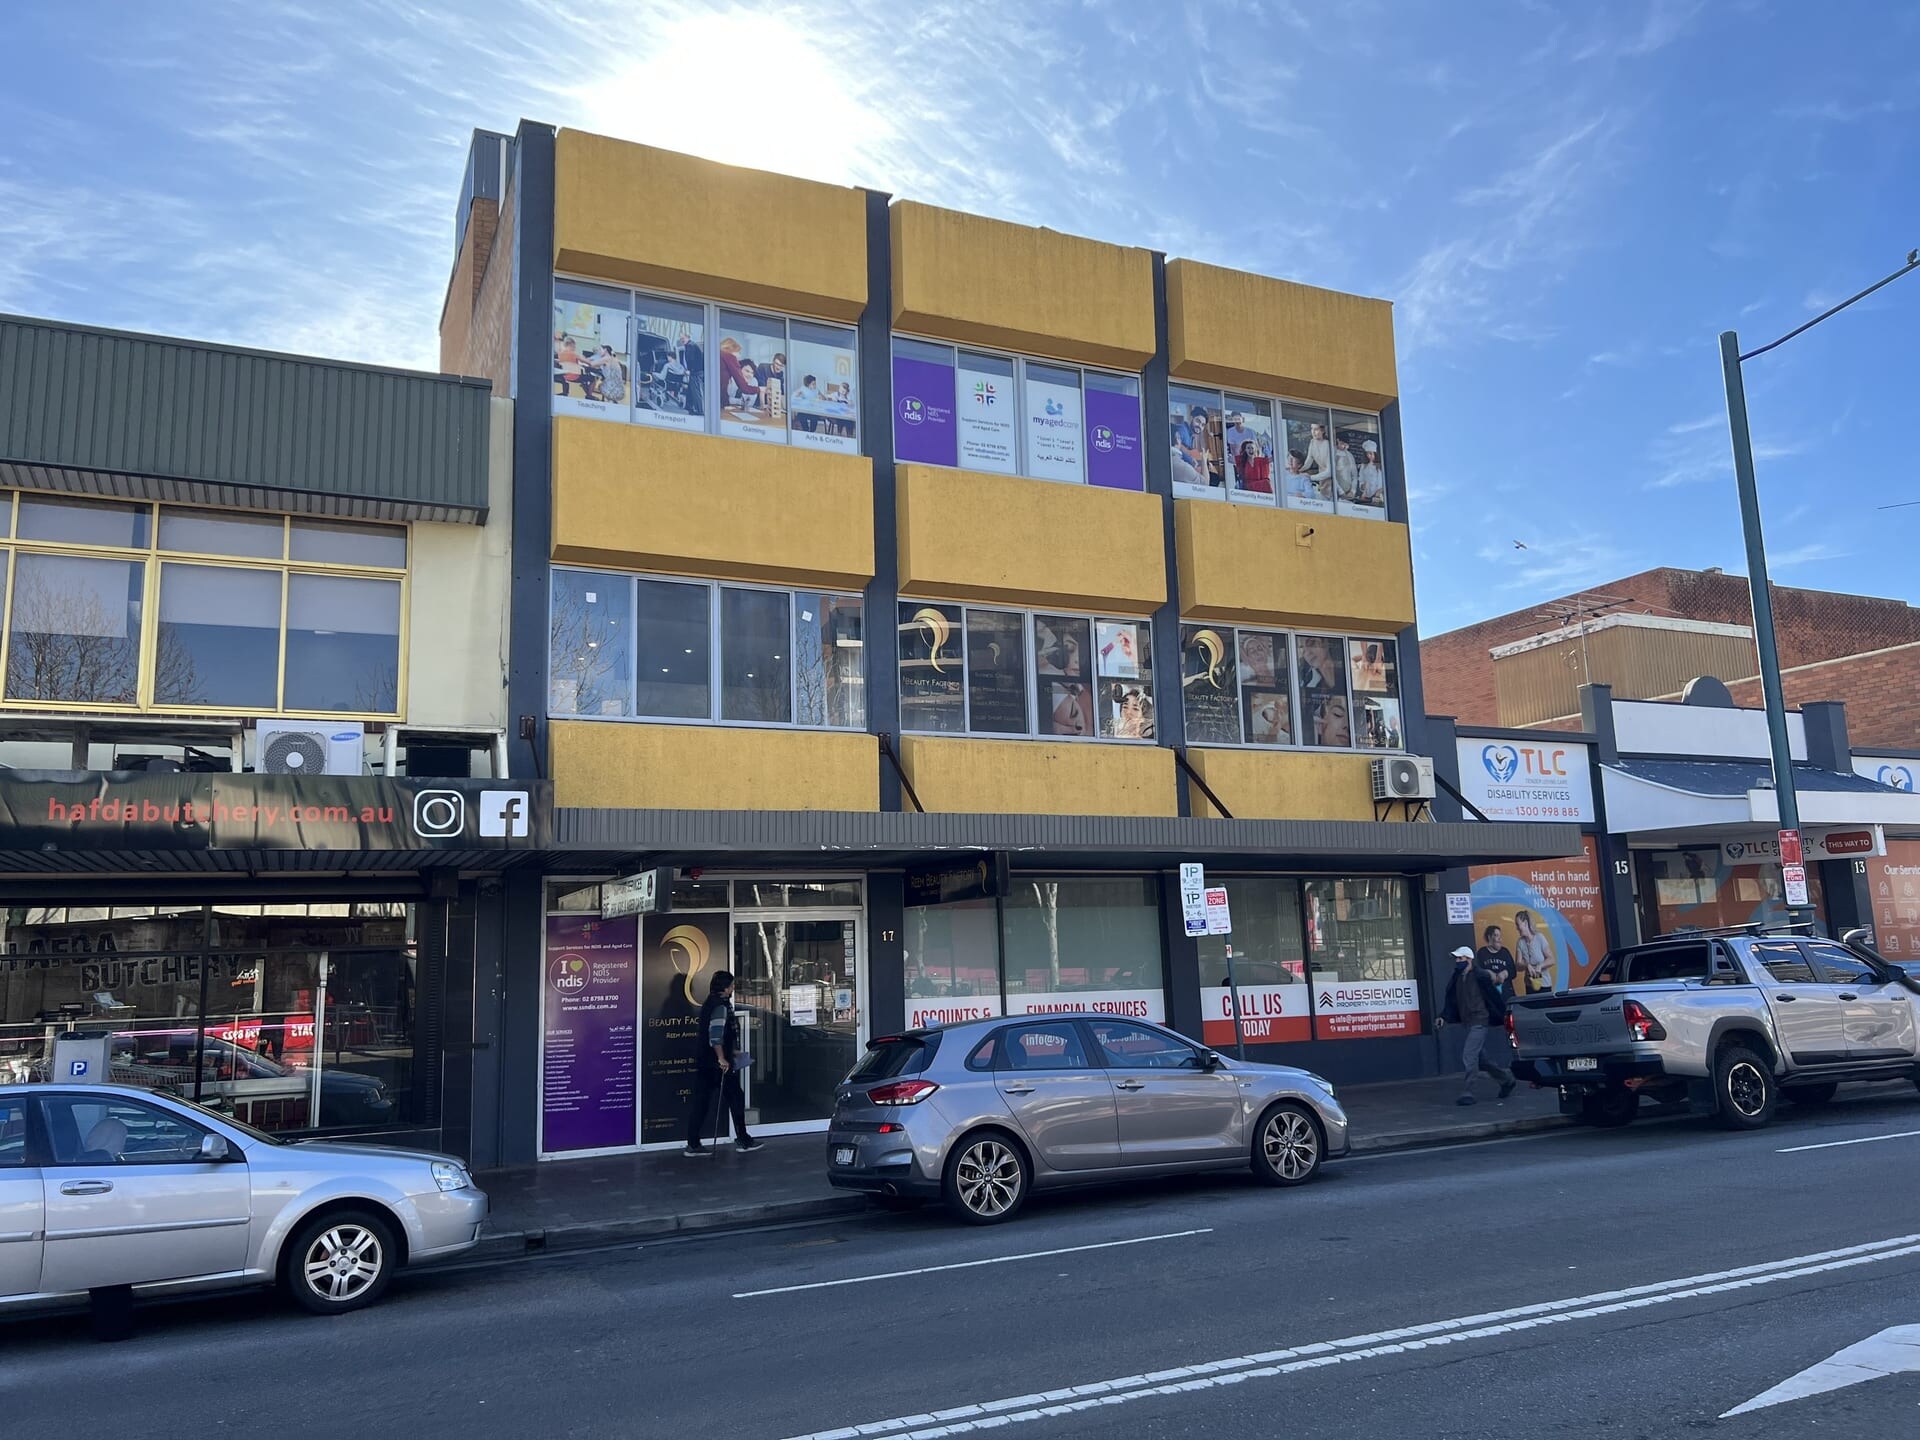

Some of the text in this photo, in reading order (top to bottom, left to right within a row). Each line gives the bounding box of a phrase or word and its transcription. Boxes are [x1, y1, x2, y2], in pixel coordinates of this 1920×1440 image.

[654, 412, 686, 423] Transport
[904, 411, 921, 421] ndis
[825, 437, 844, 445] Crafts
[1095, 439, 1111, 448] ndis
[1519, 748, 1567, 776] TLC
[1487, 789, 1570, 800] DISABILITY SERVICES
[48, 797, 395, 828] hafdabutchery.com.au
[1515, 806, 1539, 816] 1300
[1542, 807, 1559, 816] 998
[1562, 807, 1579, 816] 885
[1745, 841, 1769, 853] TLC
[1828, 841, 1843, 849] THIS
[1860, 839, 1870, 847] TO
[1185, 867, 1198, 877] 1P
[1614, 861, 1629, 874] 15
[1854, 861, 1865, 873] 13
[1884, 864, 1898, 875] Our
[1531, 870, 1590, 881] Hand in hand
[1524, 884, 1599, 897] with you on your
[1186, 893, 1200, 904] 1P
[1208, 897, 1225, 905] ZONE
[1533, 897, 1594, 910] NDIS journey.
[882, 930, 894, 941] 17
[561, 960, 567, 974] I
[592, 961, 628, 971] Registered
[557, 975, 583, 988] ndis
[592, 976, 620, 984] Provider
[1336, 987, 1411, 1001] AUSSIEWIDE
[1092, 1000, 1147, 1016] SERVICES
[1222, 993, 1282, 1017] CLL US
[648, 1017, 682, 1027] BEAUTY
[1528, 1024, 1611, 1046] TOYOTA
[73, 1062, 85, 1075] P
